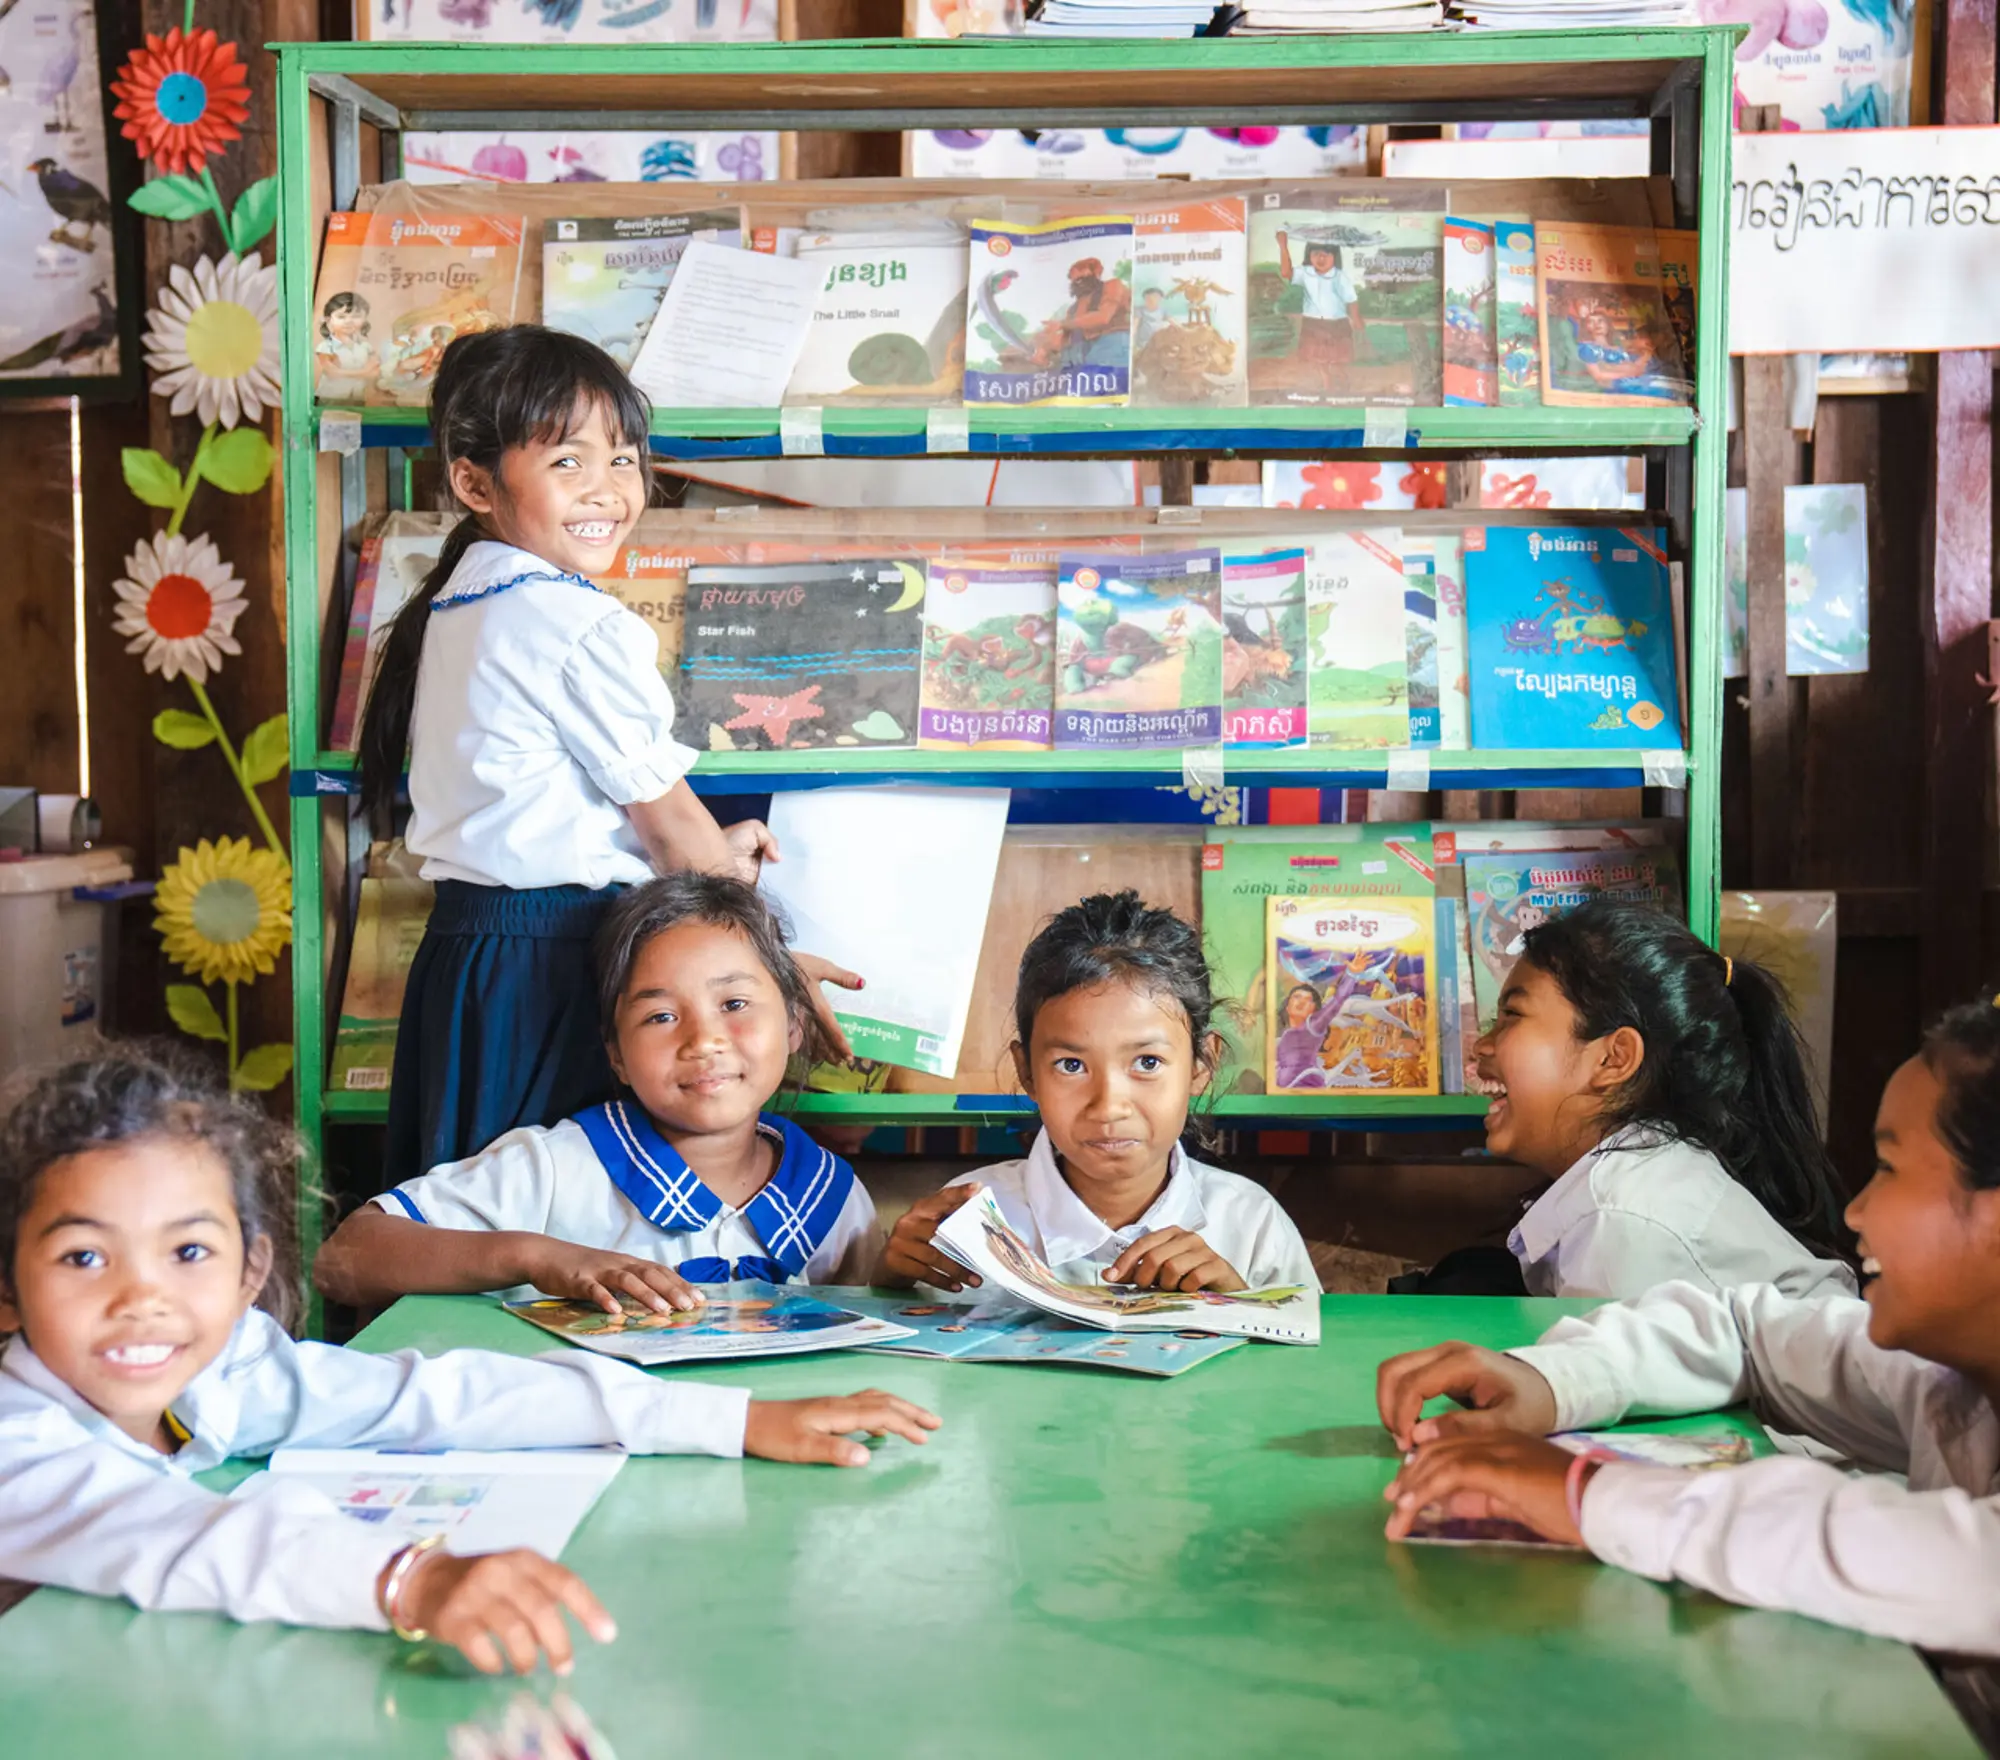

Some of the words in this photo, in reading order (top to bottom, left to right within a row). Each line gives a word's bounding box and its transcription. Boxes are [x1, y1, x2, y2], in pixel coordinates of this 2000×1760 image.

[837, 309, 866, 320] Little
[870, 308, 900, 319] Snail
[697, 625, 725, 637] Star
[727, 624, 756, 637] Fish
[1530, 892, 1553, 907] My
